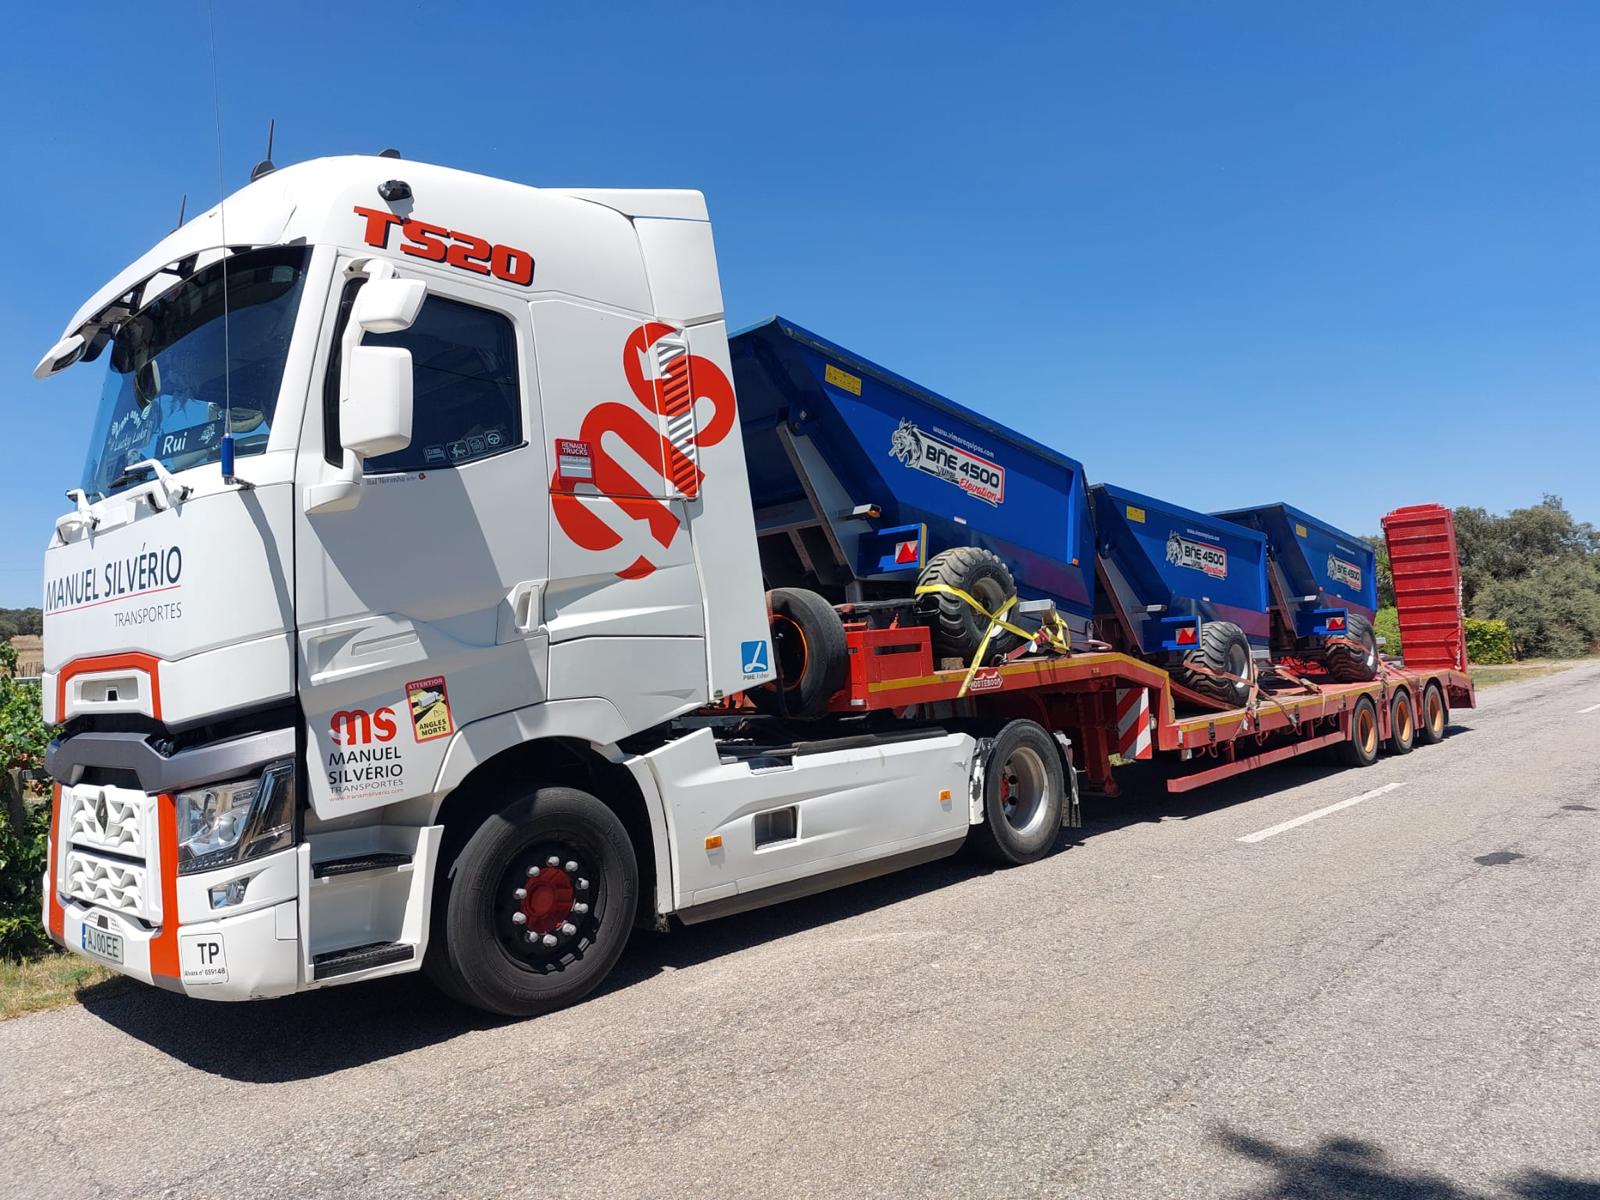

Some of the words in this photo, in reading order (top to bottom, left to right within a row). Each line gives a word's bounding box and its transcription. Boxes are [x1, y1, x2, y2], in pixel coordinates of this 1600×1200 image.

[162, 431, 187, 456] Rui
[561, 441, 588, 450] RENAULT
[562, 447, 588, 456] TRUCKS
[958, 461, 1000, 489] 4500
[960, 478, 998, 501] Elevation
[1202, 551, 1225, 566] 4500
[45, 567, 99, 613] MANUEL
[104, 541, 182, 598] SILVÉRIO
[114, 601, 182, 628] TRANSPORTES
[408, 679, 443, 690] ATTENTION
[419, 718, 447, 730] ANGLES
[421, 725, 447, 736] MORTS
[328, 746, 402, 767] MANUEL
[328, 763, 403, 785] SILVÉRIO
[329, 779, 404, 794] TRANSPORTES
[197, 942, 220, 965] TP
